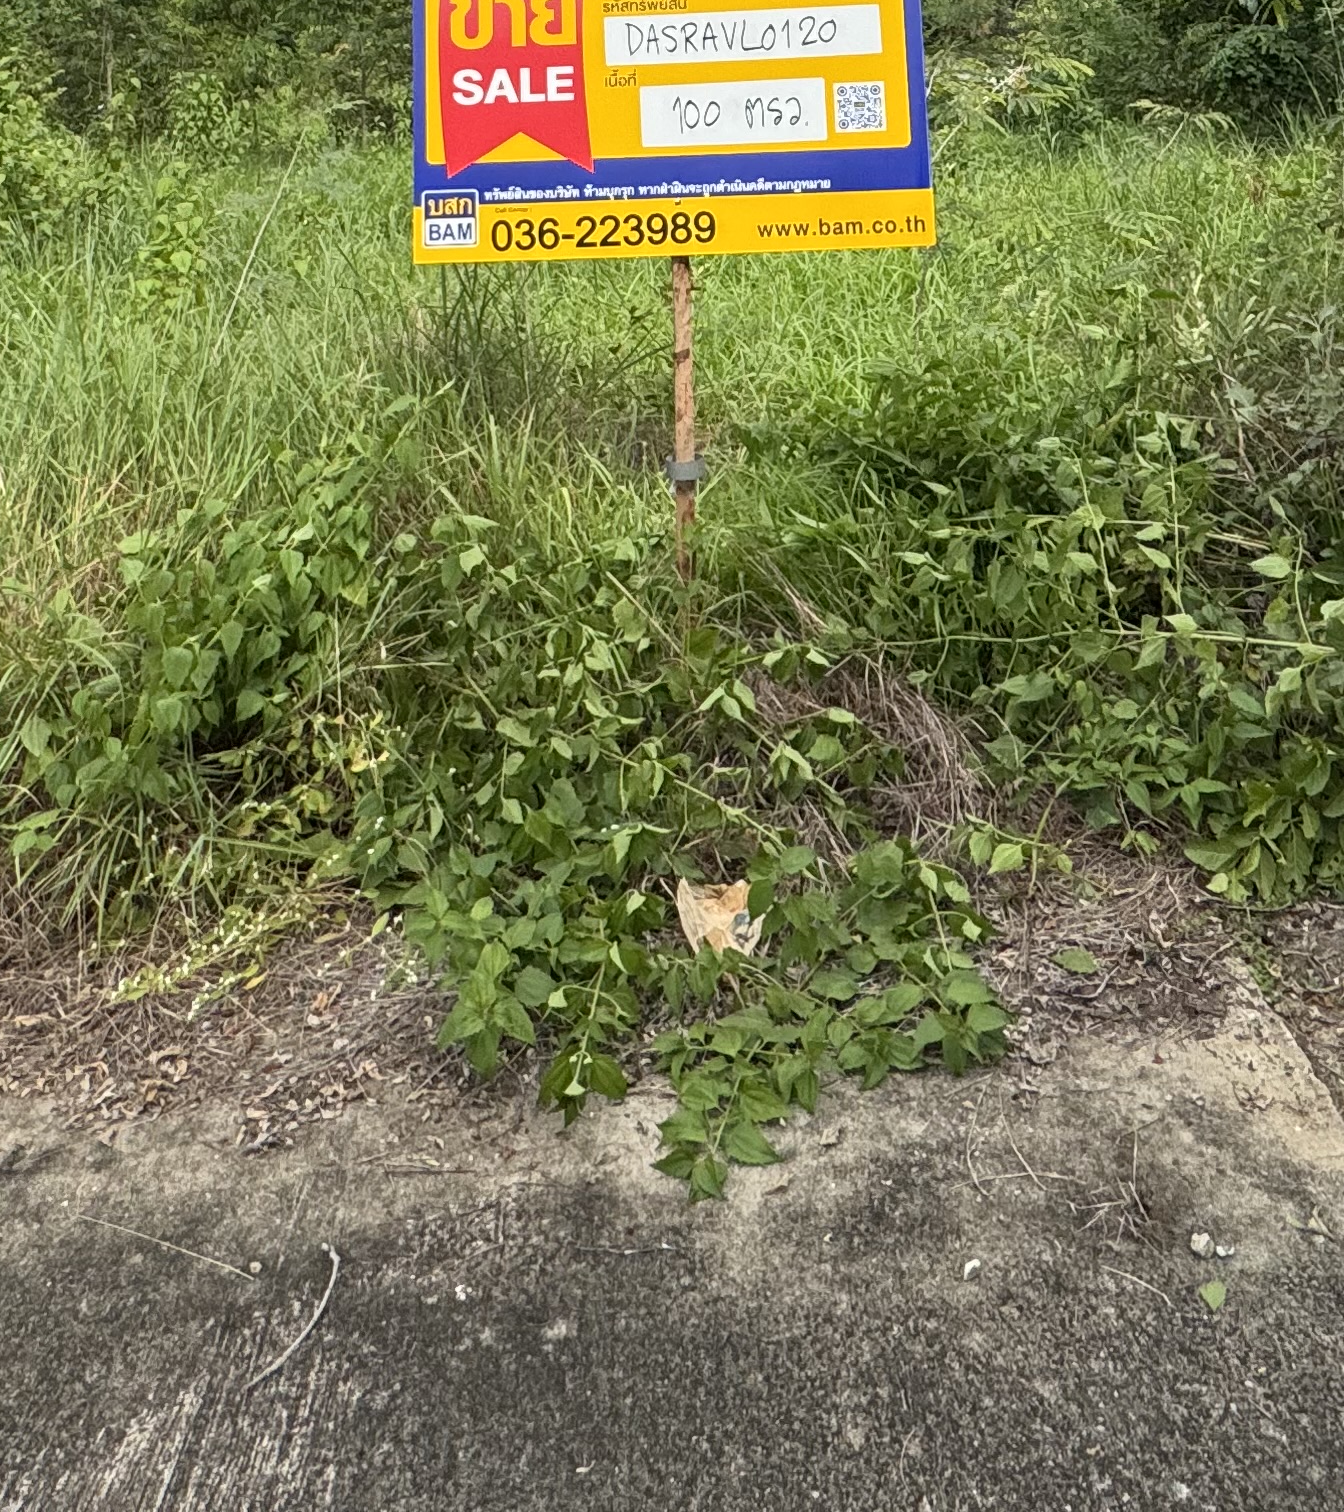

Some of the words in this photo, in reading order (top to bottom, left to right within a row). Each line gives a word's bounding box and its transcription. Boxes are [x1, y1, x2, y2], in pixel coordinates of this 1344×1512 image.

[452, 66, 575, 106] SALE
[604, 69, 637, 88] เนื้อที่
[672, 96, 721, 134] 100
[428, 196, 473, 216] บสก
[429, 223, 472, 241] BAM
[491, 211, 716, 252] 036-223989
[757, 215, 926, 237] www.bam.co.th
